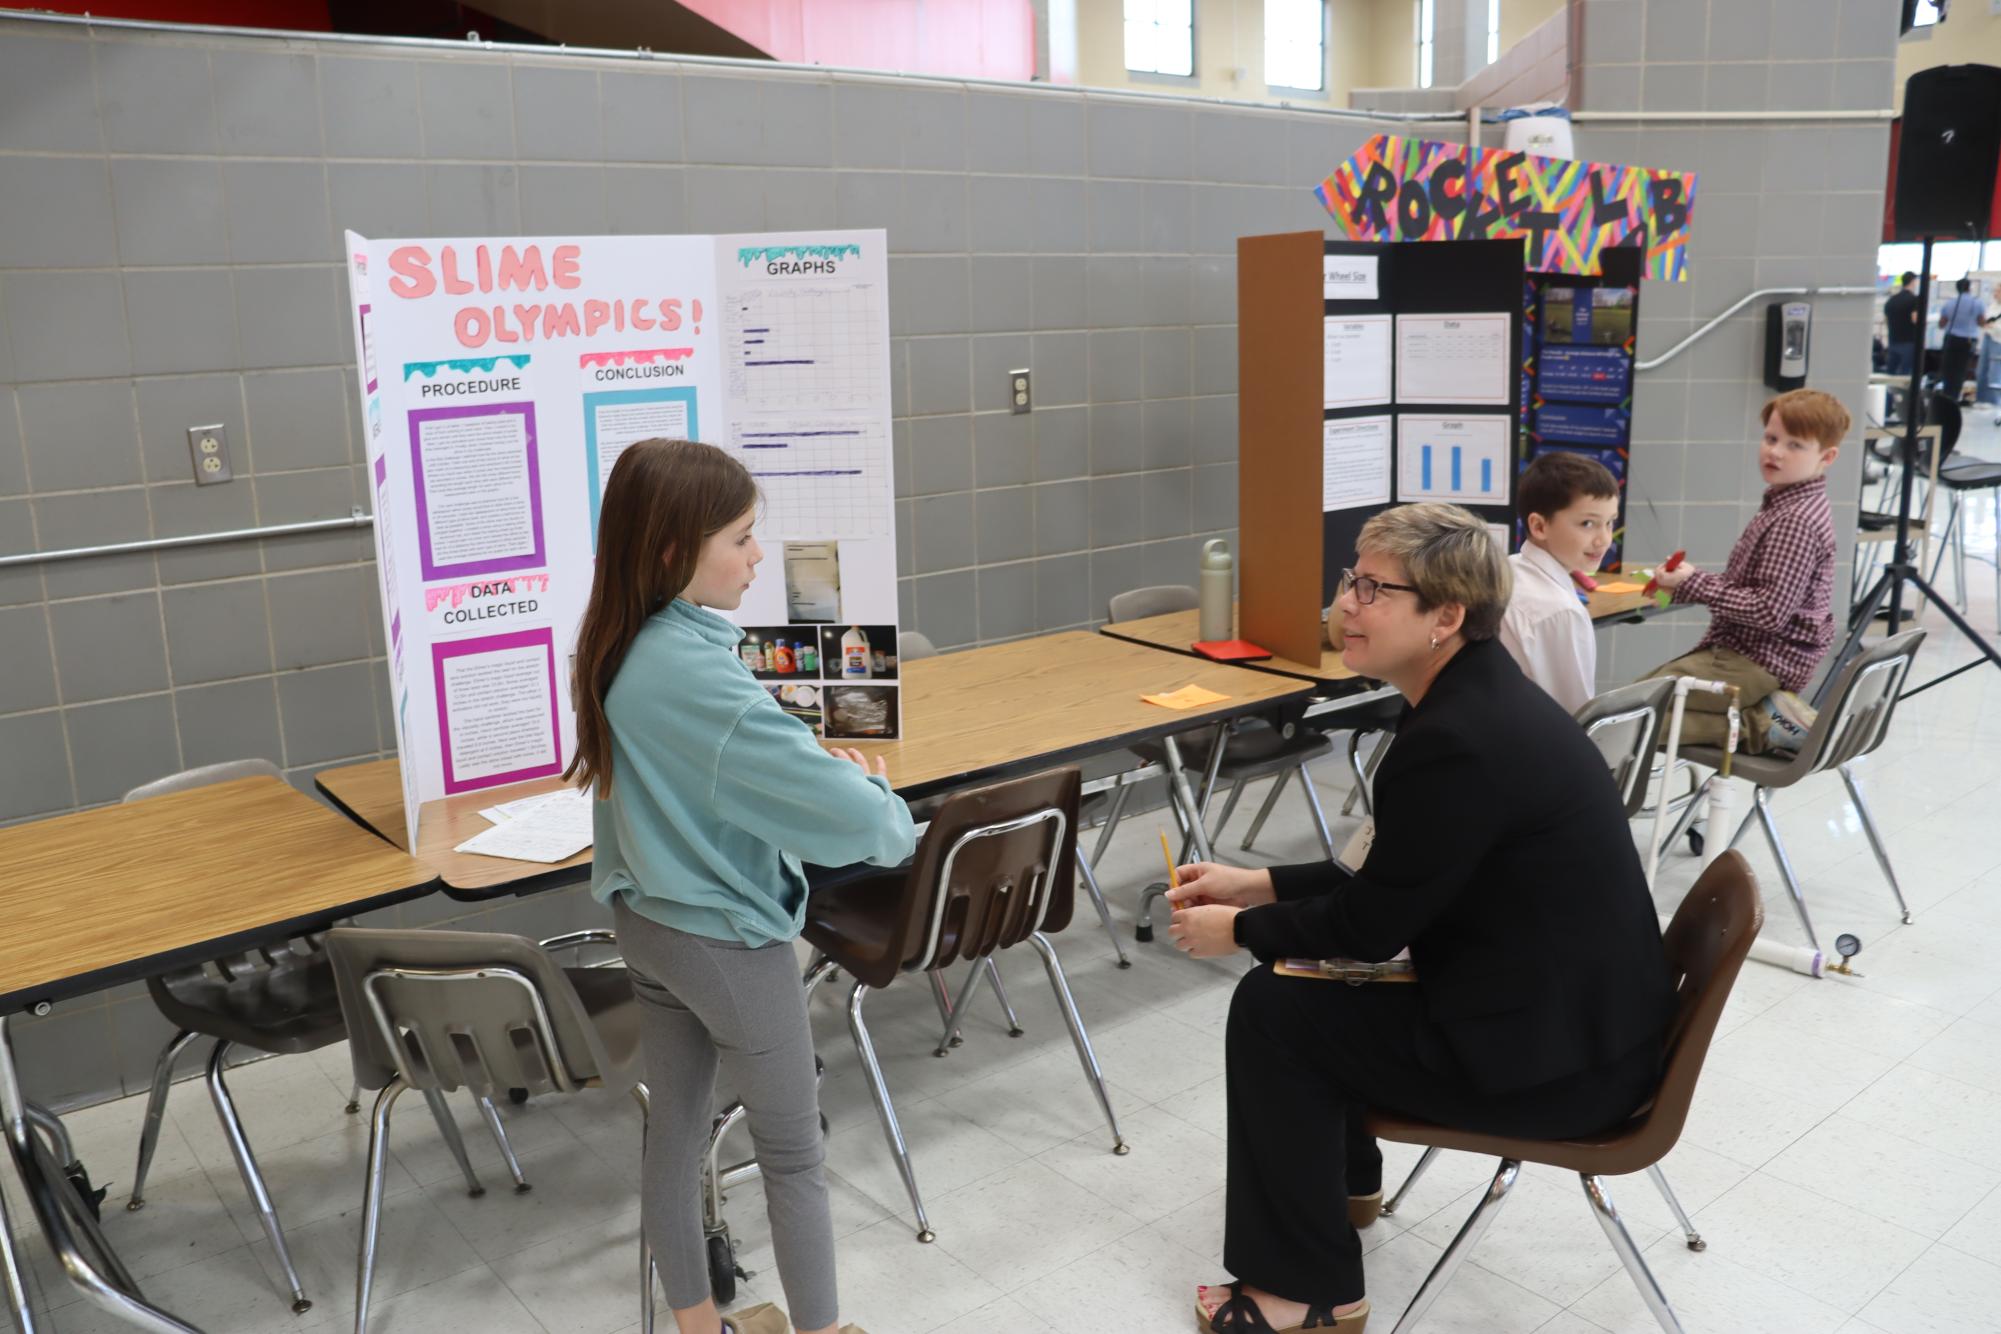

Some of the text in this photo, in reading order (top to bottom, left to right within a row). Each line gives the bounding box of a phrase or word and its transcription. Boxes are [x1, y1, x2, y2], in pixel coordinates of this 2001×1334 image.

[1351, 150, 1560, 267] ROCKET
[388, 244, 582, 299] SLIME
[767, 260, 836, 275] GRAPHS
[454, 298, 703, 349] OLYMPICS!
[595, 364, 684, 382] CONCLUSION
[421, 377, 521, 398] PROCEDURE
[471, 581, 512, 598] DATA
[444, 599, 538, 624] COLLECTED
[1771, 712, 1800, 735] HOKA
